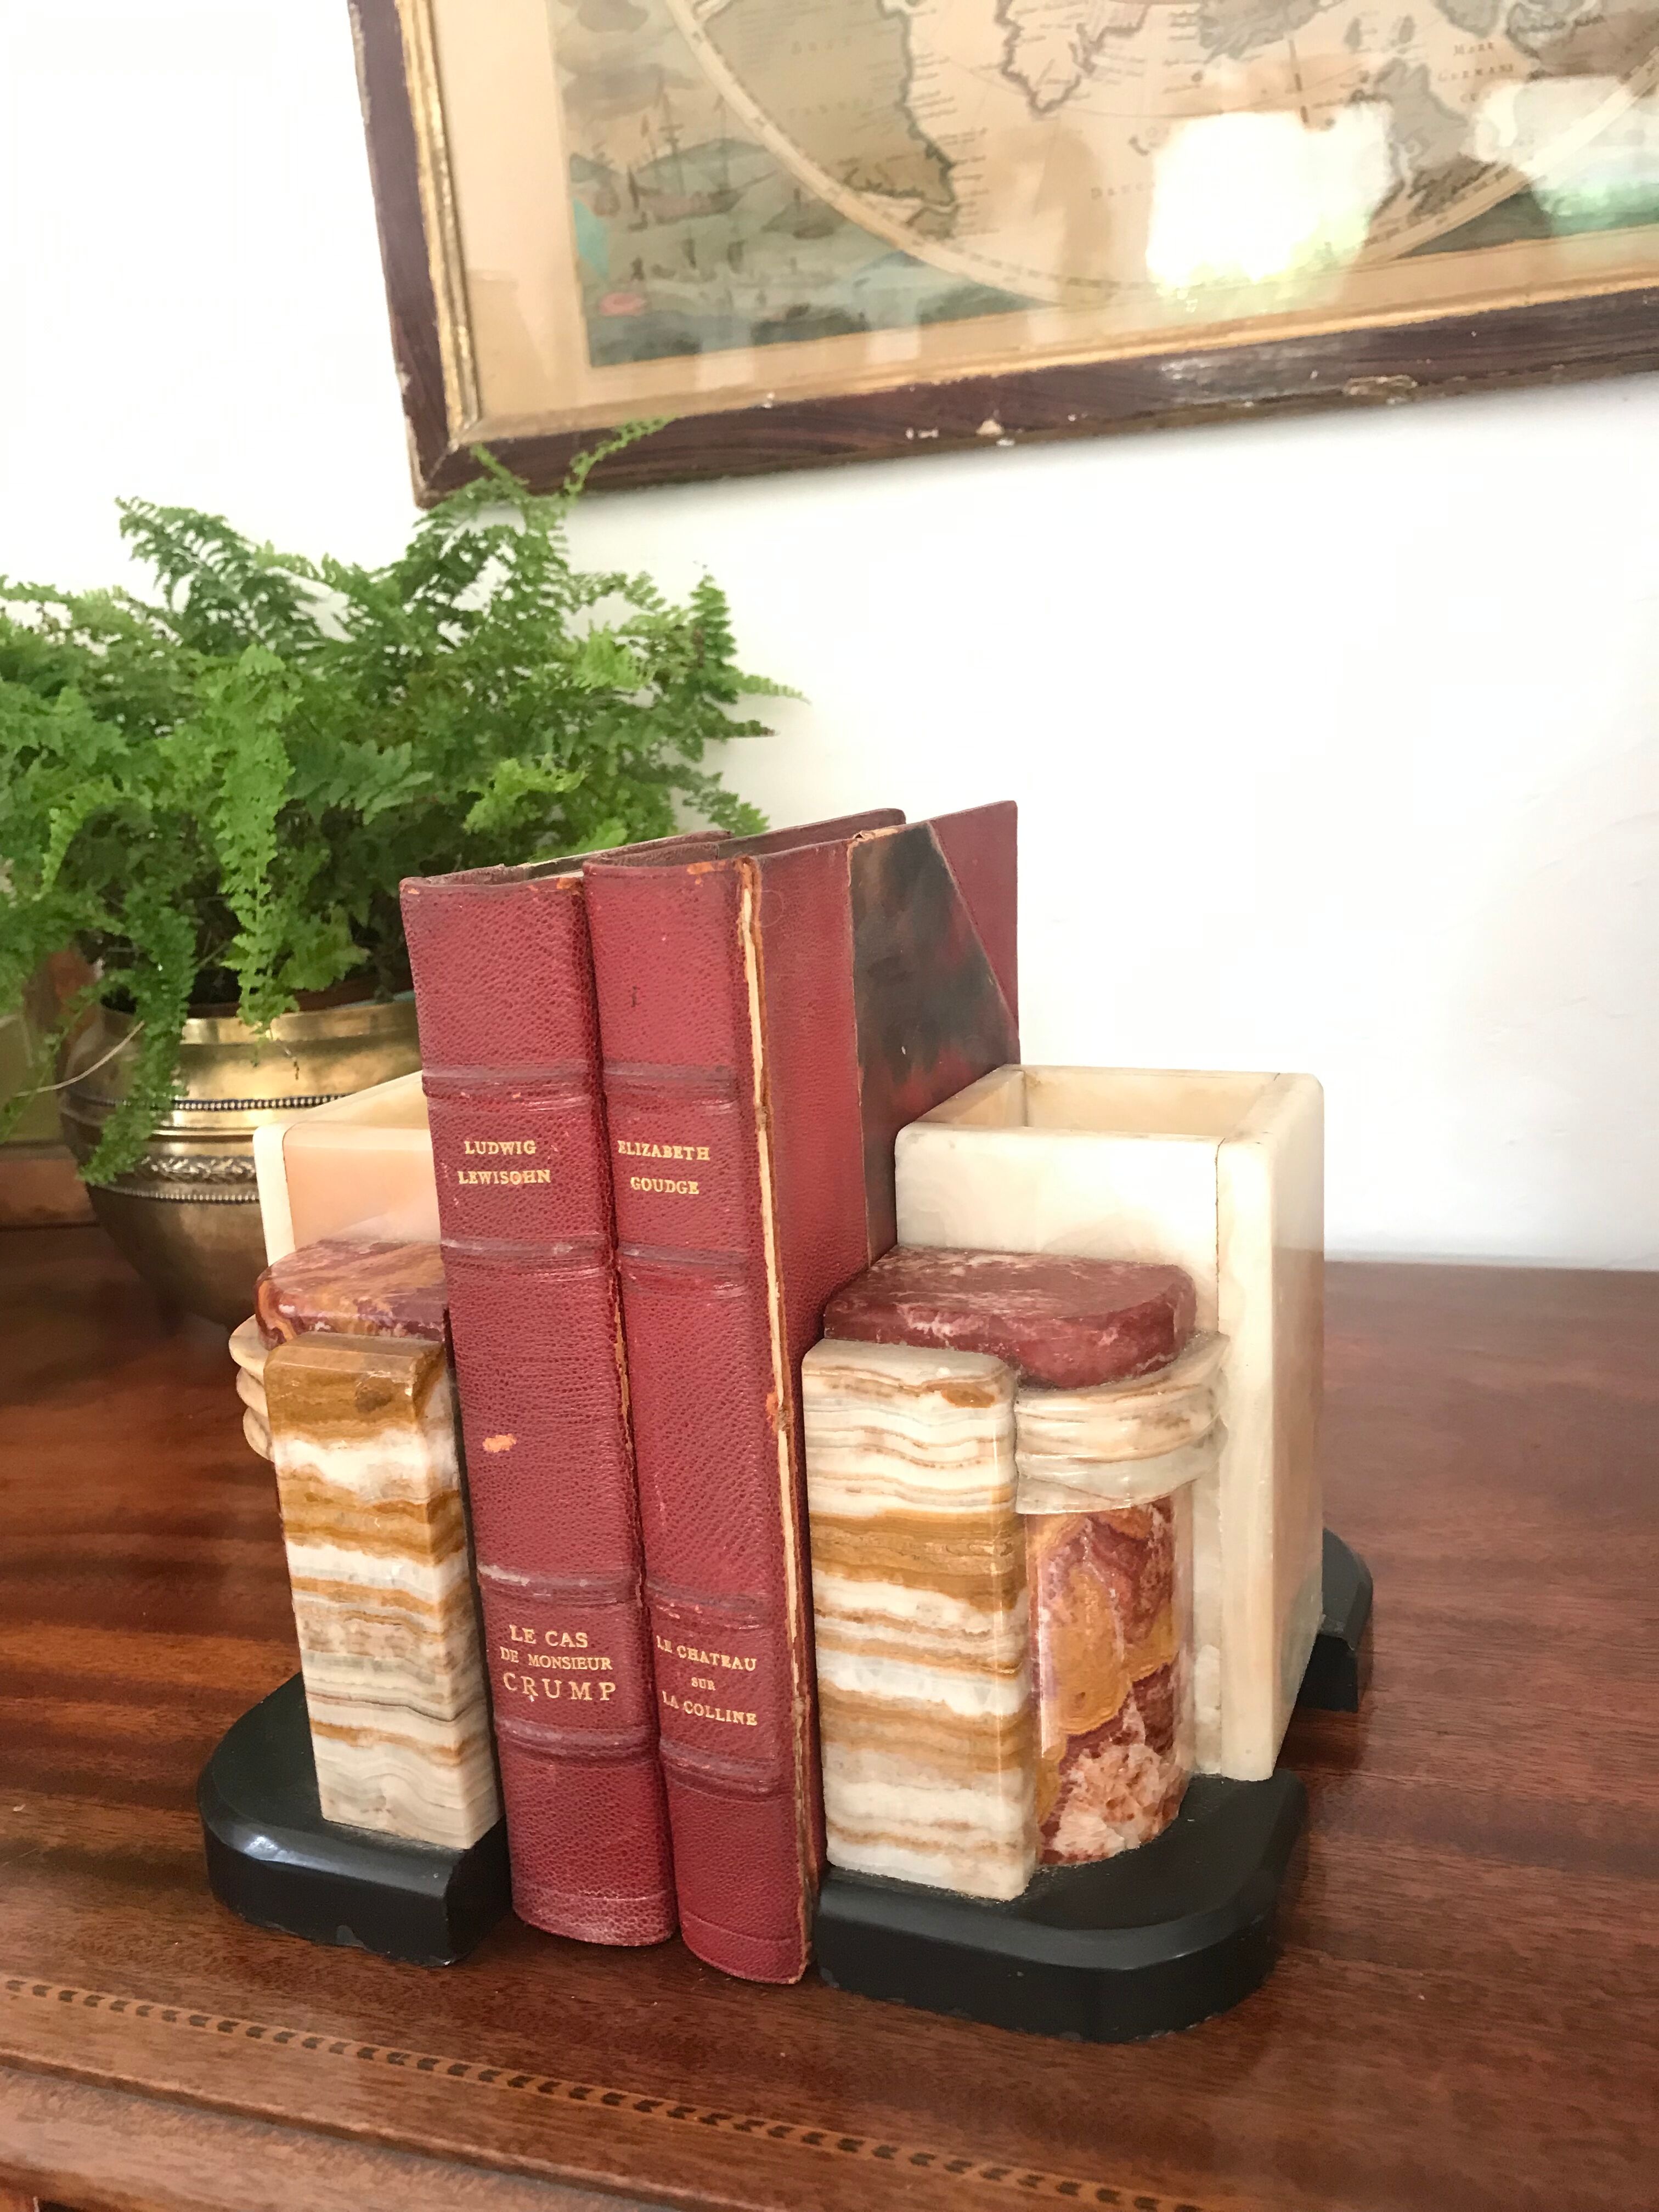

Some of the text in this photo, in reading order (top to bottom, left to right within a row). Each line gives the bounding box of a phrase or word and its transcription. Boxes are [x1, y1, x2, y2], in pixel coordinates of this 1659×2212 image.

[464, 1140, 536, 1155] LUDWIG
[618, 1140, 710, 1161] ELIZABETH
[458, 1169, 551, 1185] LEWISOHN
[630, 1176, 700, 1195] GOUDGE
[509, 1624, 588, 1648] LE CAS
[500, 1646, 613, 1671] DE MONSIEUR
[656, 1635, 757, 1672] LE CHATEAU
[503, 1672, 616, 1701] CRUMP
[691, 1677, 716, 1691] SUR
[662, 1691, 758, 1726] LA COLLINE
